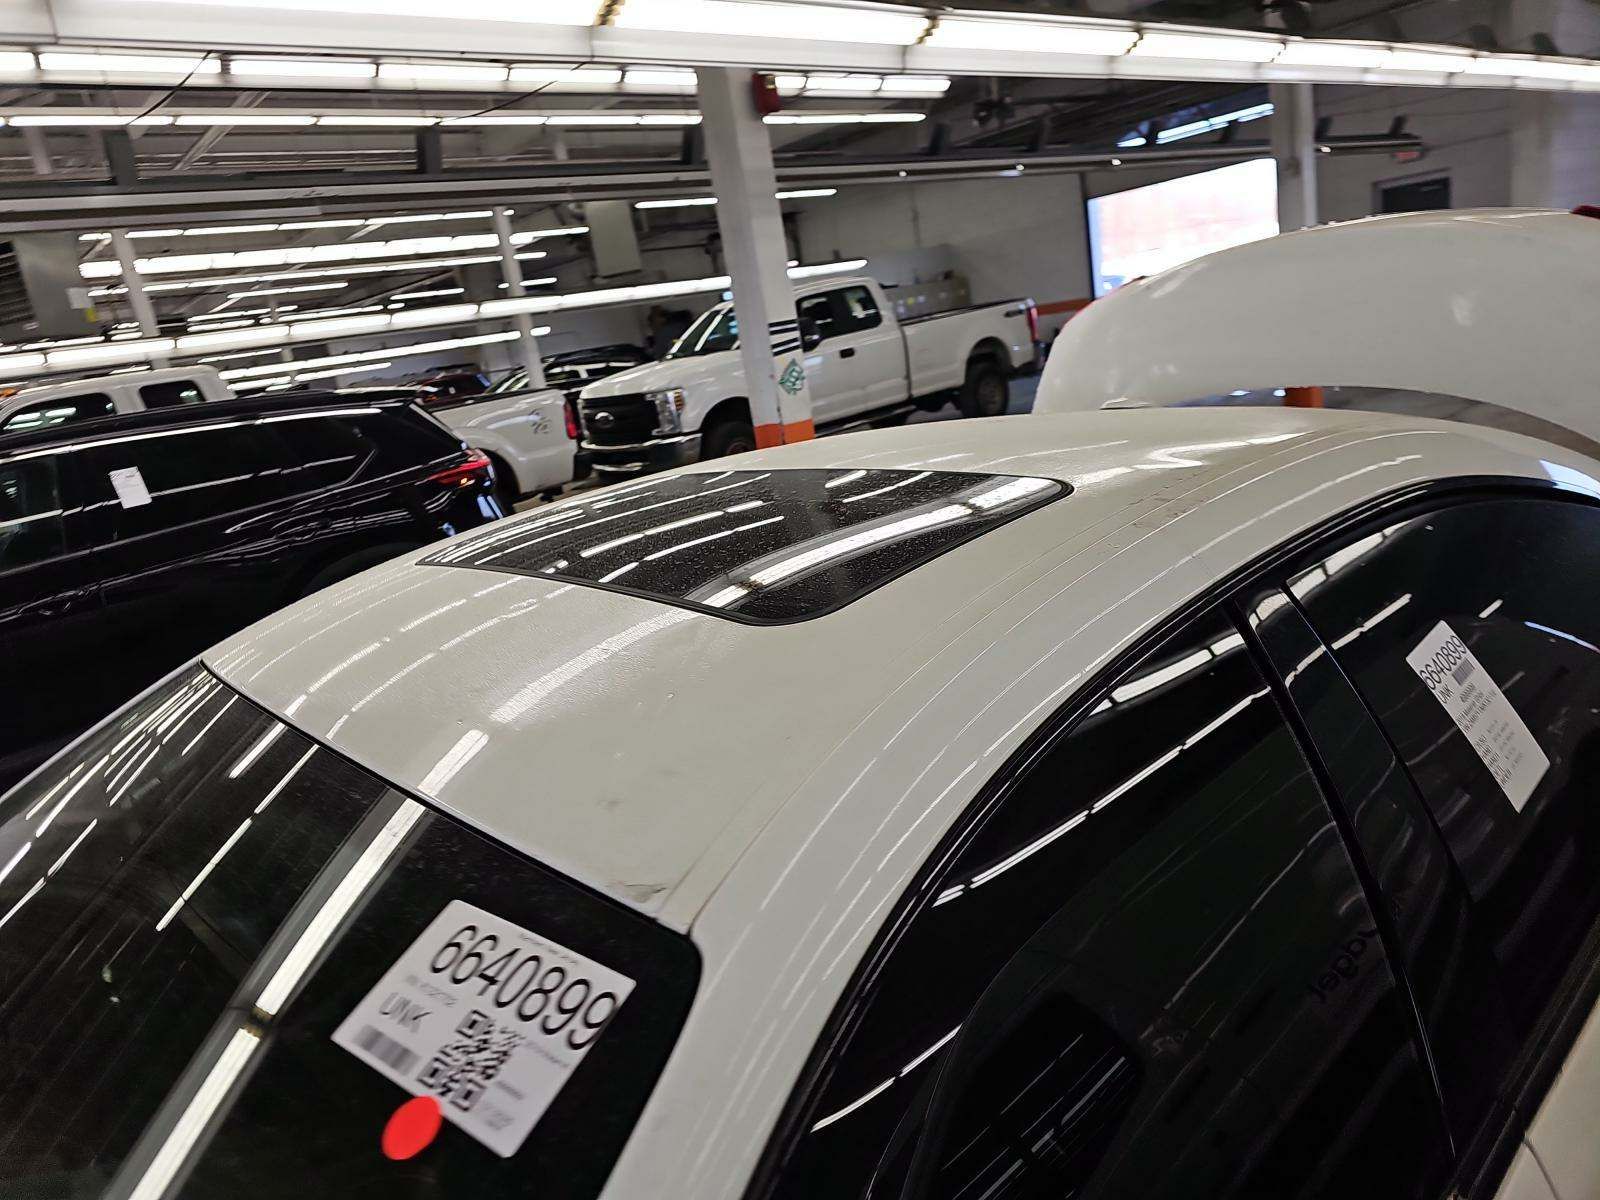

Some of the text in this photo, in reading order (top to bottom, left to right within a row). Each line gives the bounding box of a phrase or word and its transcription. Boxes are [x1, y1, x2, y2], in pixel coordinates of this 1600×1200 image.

[1418, 635, 1467, 691] 6640899
[378, 992, 433, 1035] UNK
[430, 924, 618, 1051] 6640899
